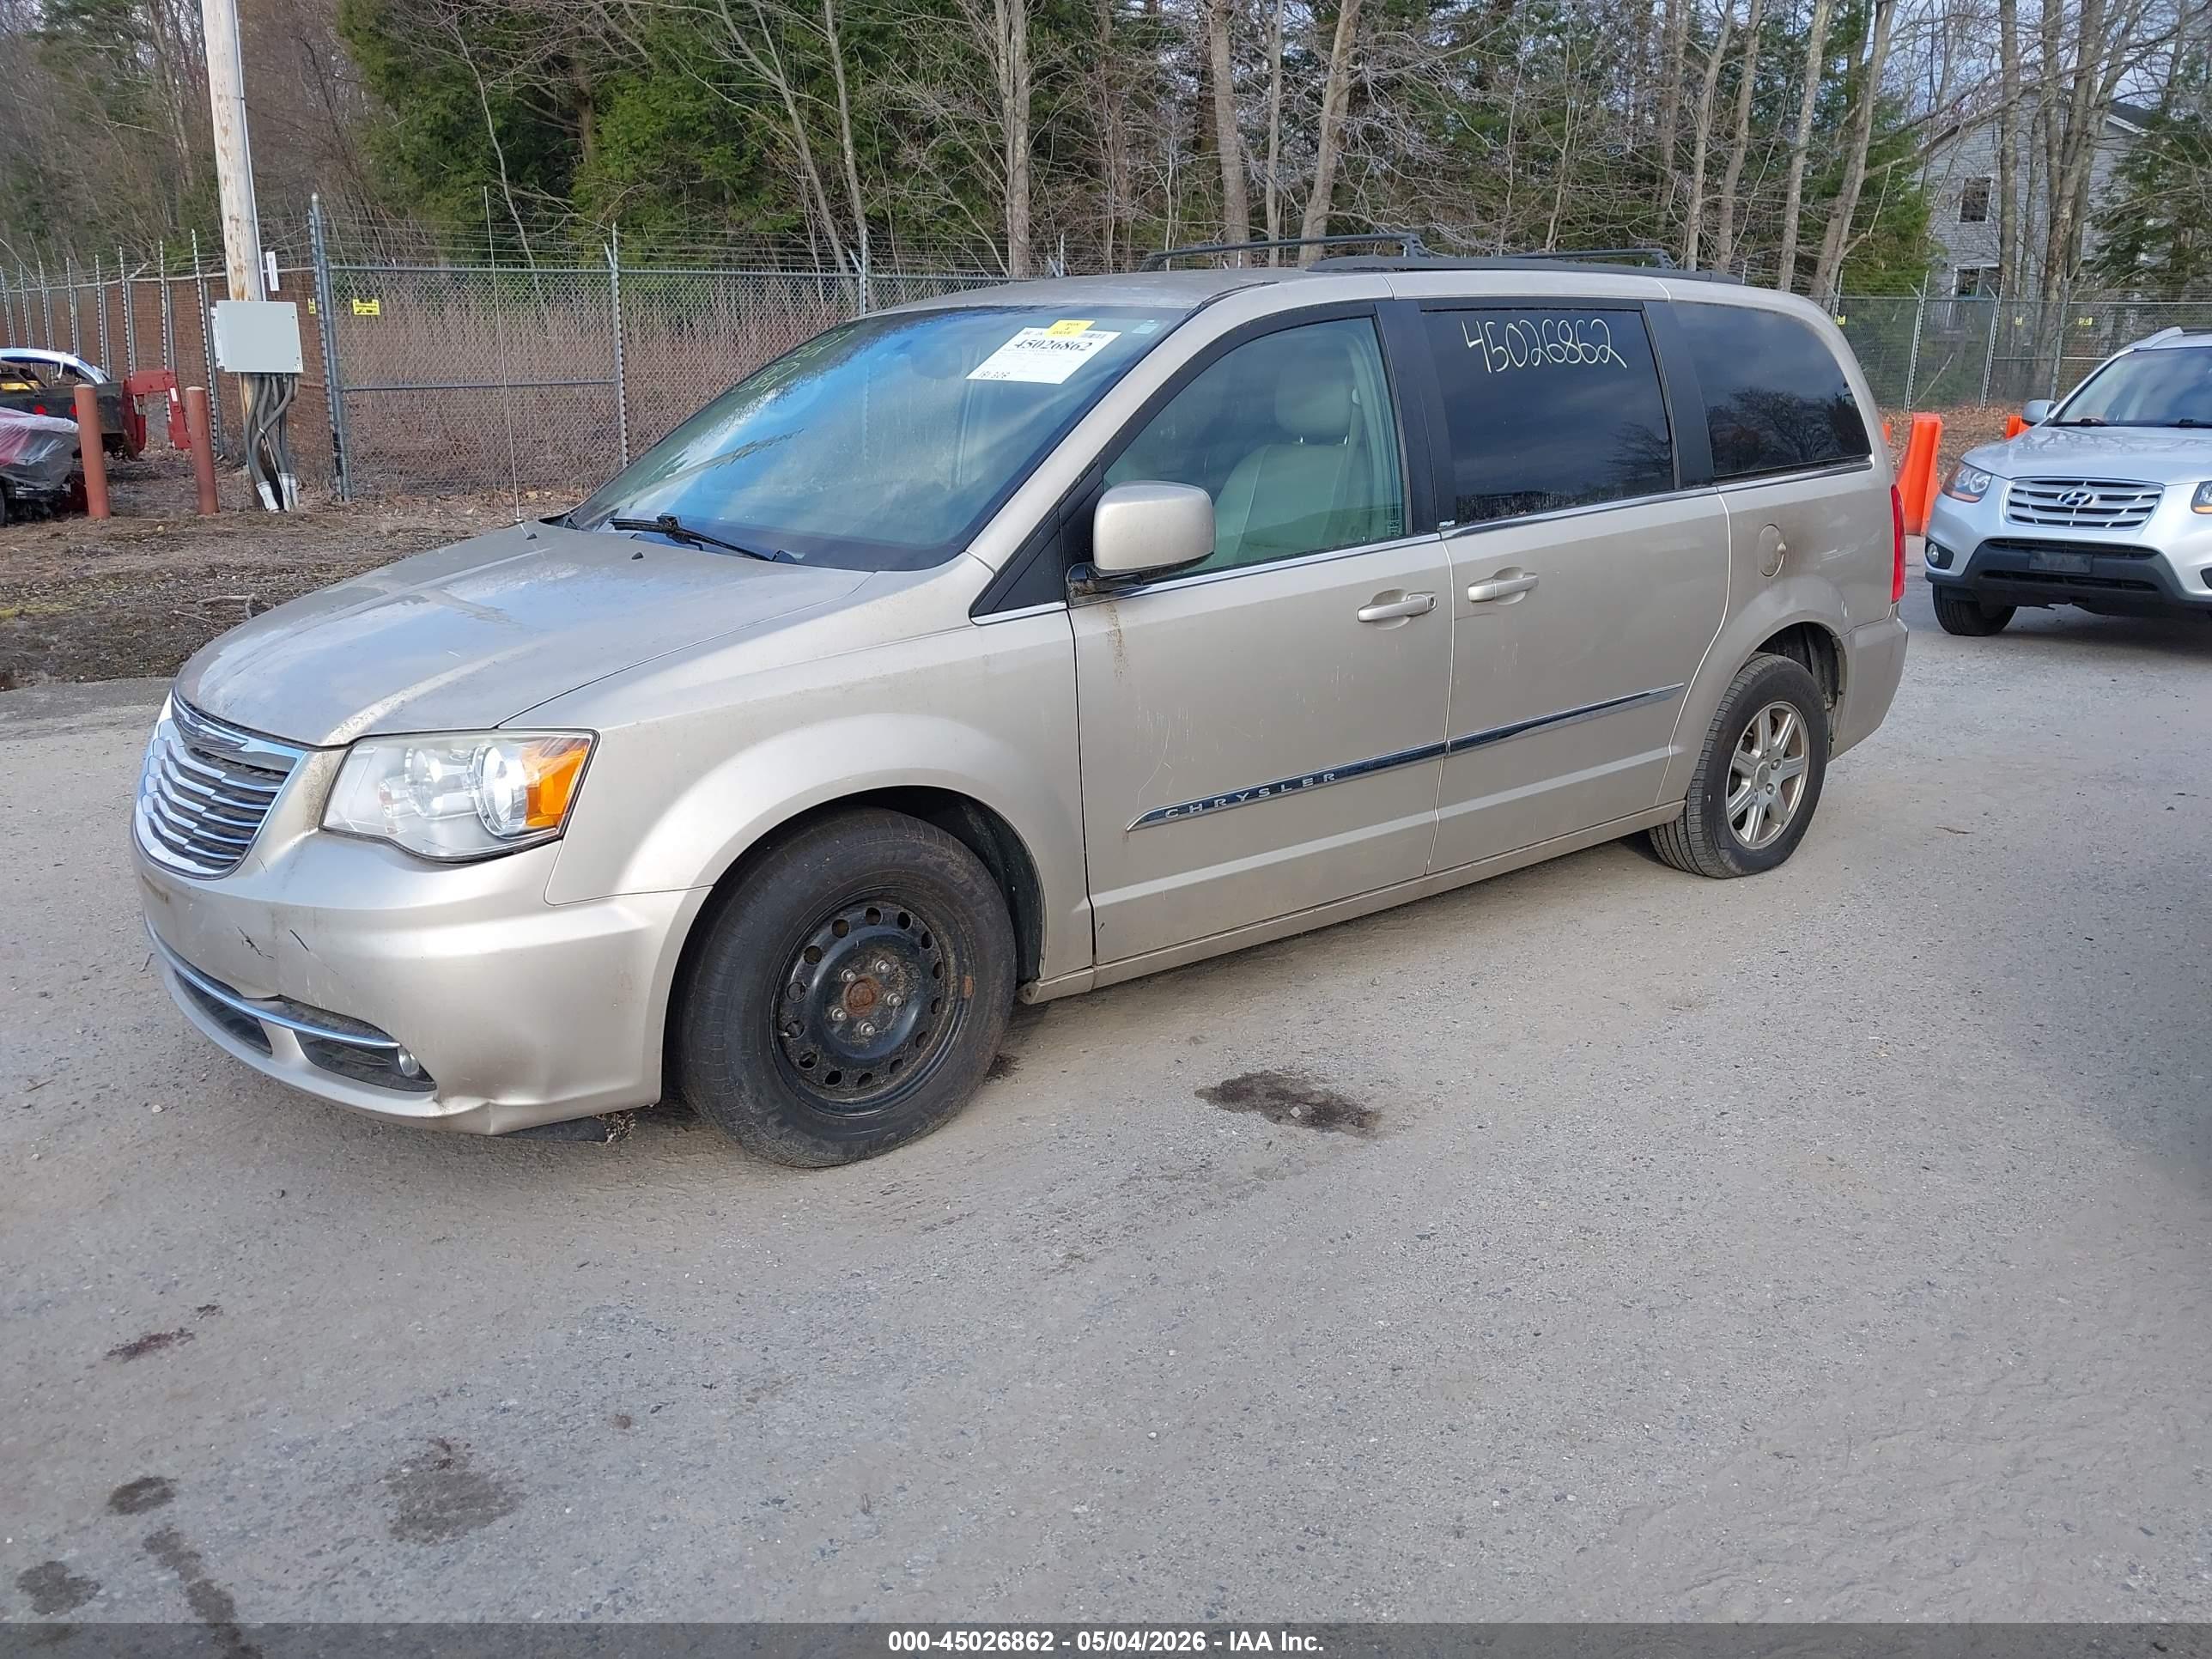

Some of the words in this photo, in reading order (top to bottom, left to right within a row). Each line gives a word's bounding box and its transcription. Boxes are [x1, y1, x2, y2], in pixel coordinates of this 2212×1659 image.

[1014, 338, 1093, 351] 45026862
[1462, 319, 1628, 374] 45026862
[1165, 773, 1335, 818] CHRYSLER
